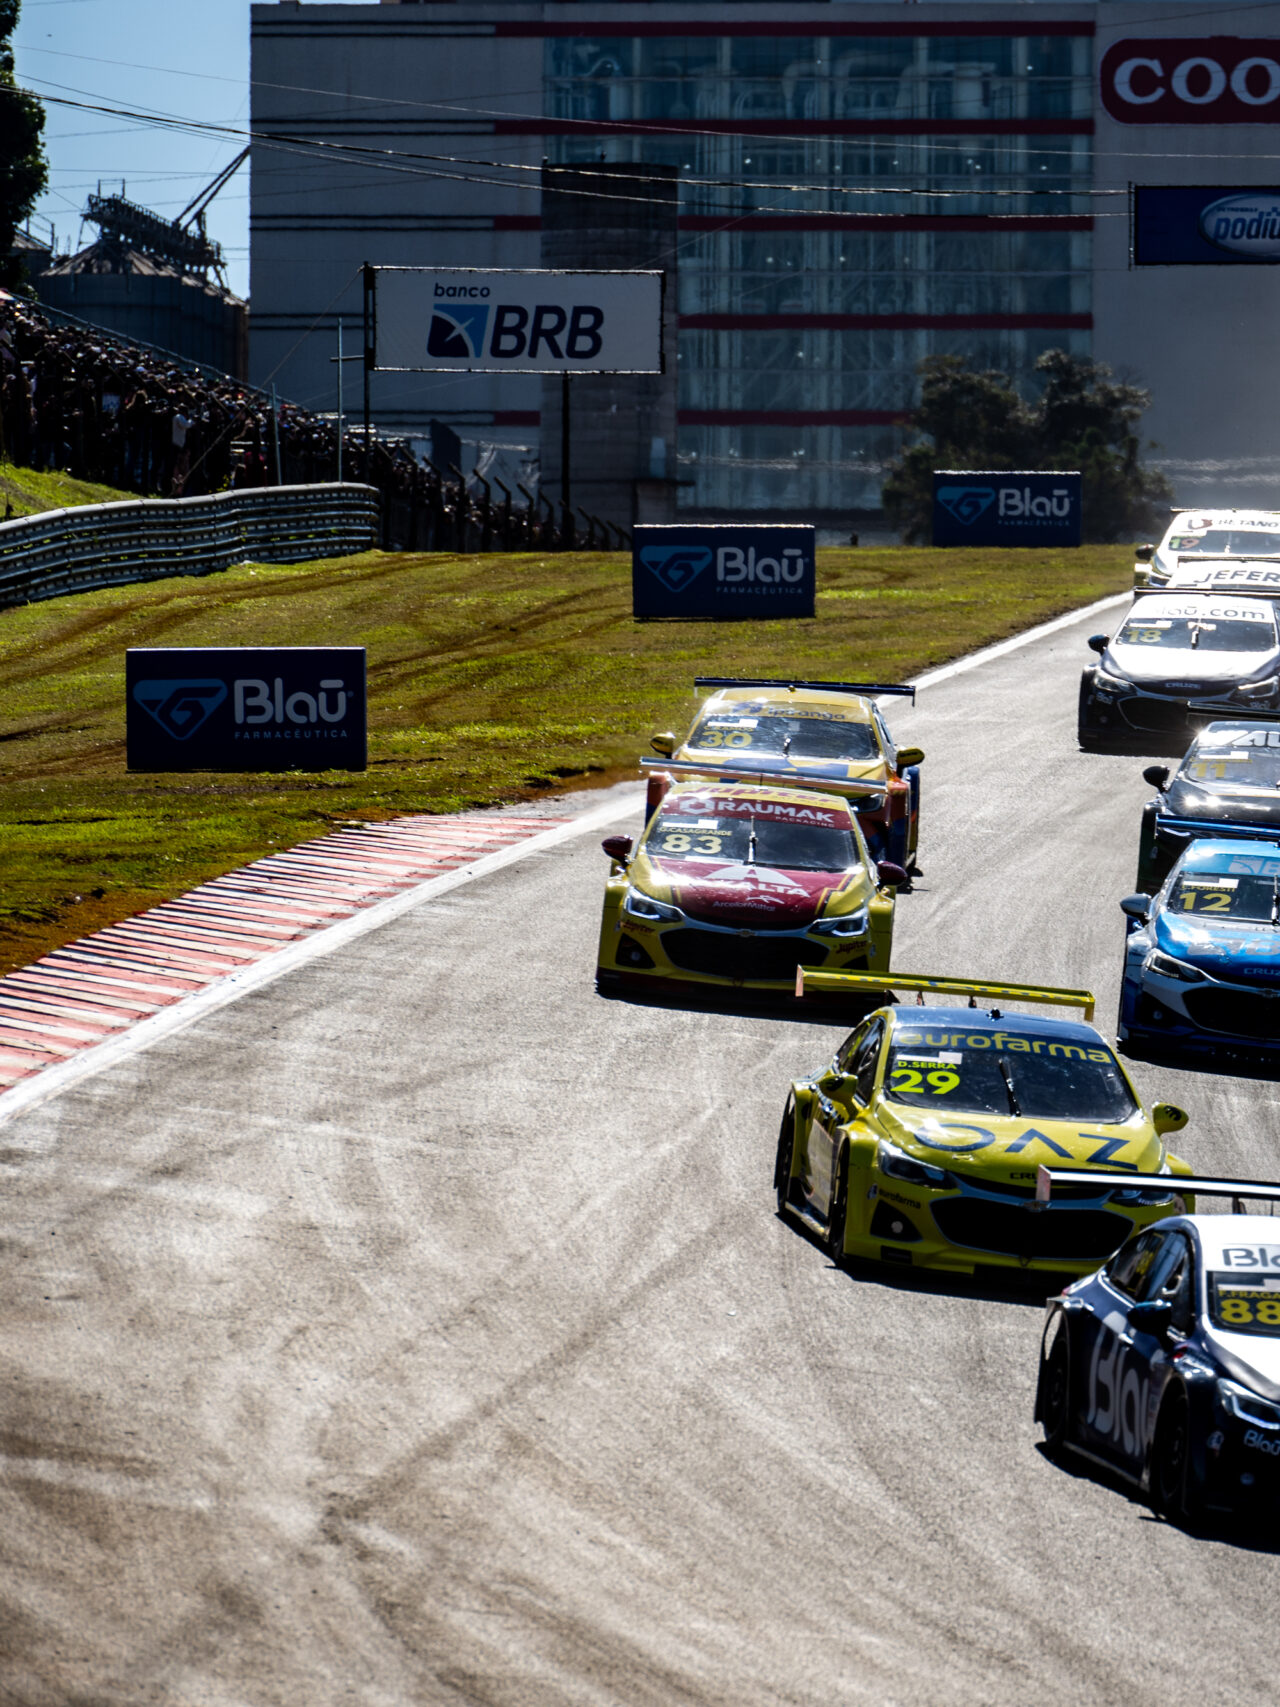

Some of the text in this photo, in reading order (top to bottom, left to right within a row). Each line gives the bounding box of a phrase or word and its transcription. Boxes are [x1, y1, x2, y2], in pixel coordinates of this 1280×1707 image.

[433, 282, 491, 298] banco
[489, 304, 604, 359] BRB
[1169, 537, 1200, 549] 19
[1126, 629, 1163, 643] 18
[234, 729, 348, 740] FARMACÊUTICA
[698, 731, 753, 749] 30
[1191, 762, 1227, 778] 11
[717, 801, 835, 824] RAUMAK
[661, 834, 722, 855] 83
[712, 900, 777, 912] ArcelorMittal
[1179, 891, 1233, 913] 12
[899, 1031, 1112, 1065] eurofarma
[897, 1059, 957, 1071] D.SERRA
[889, 1069, 961, 1095] 29
